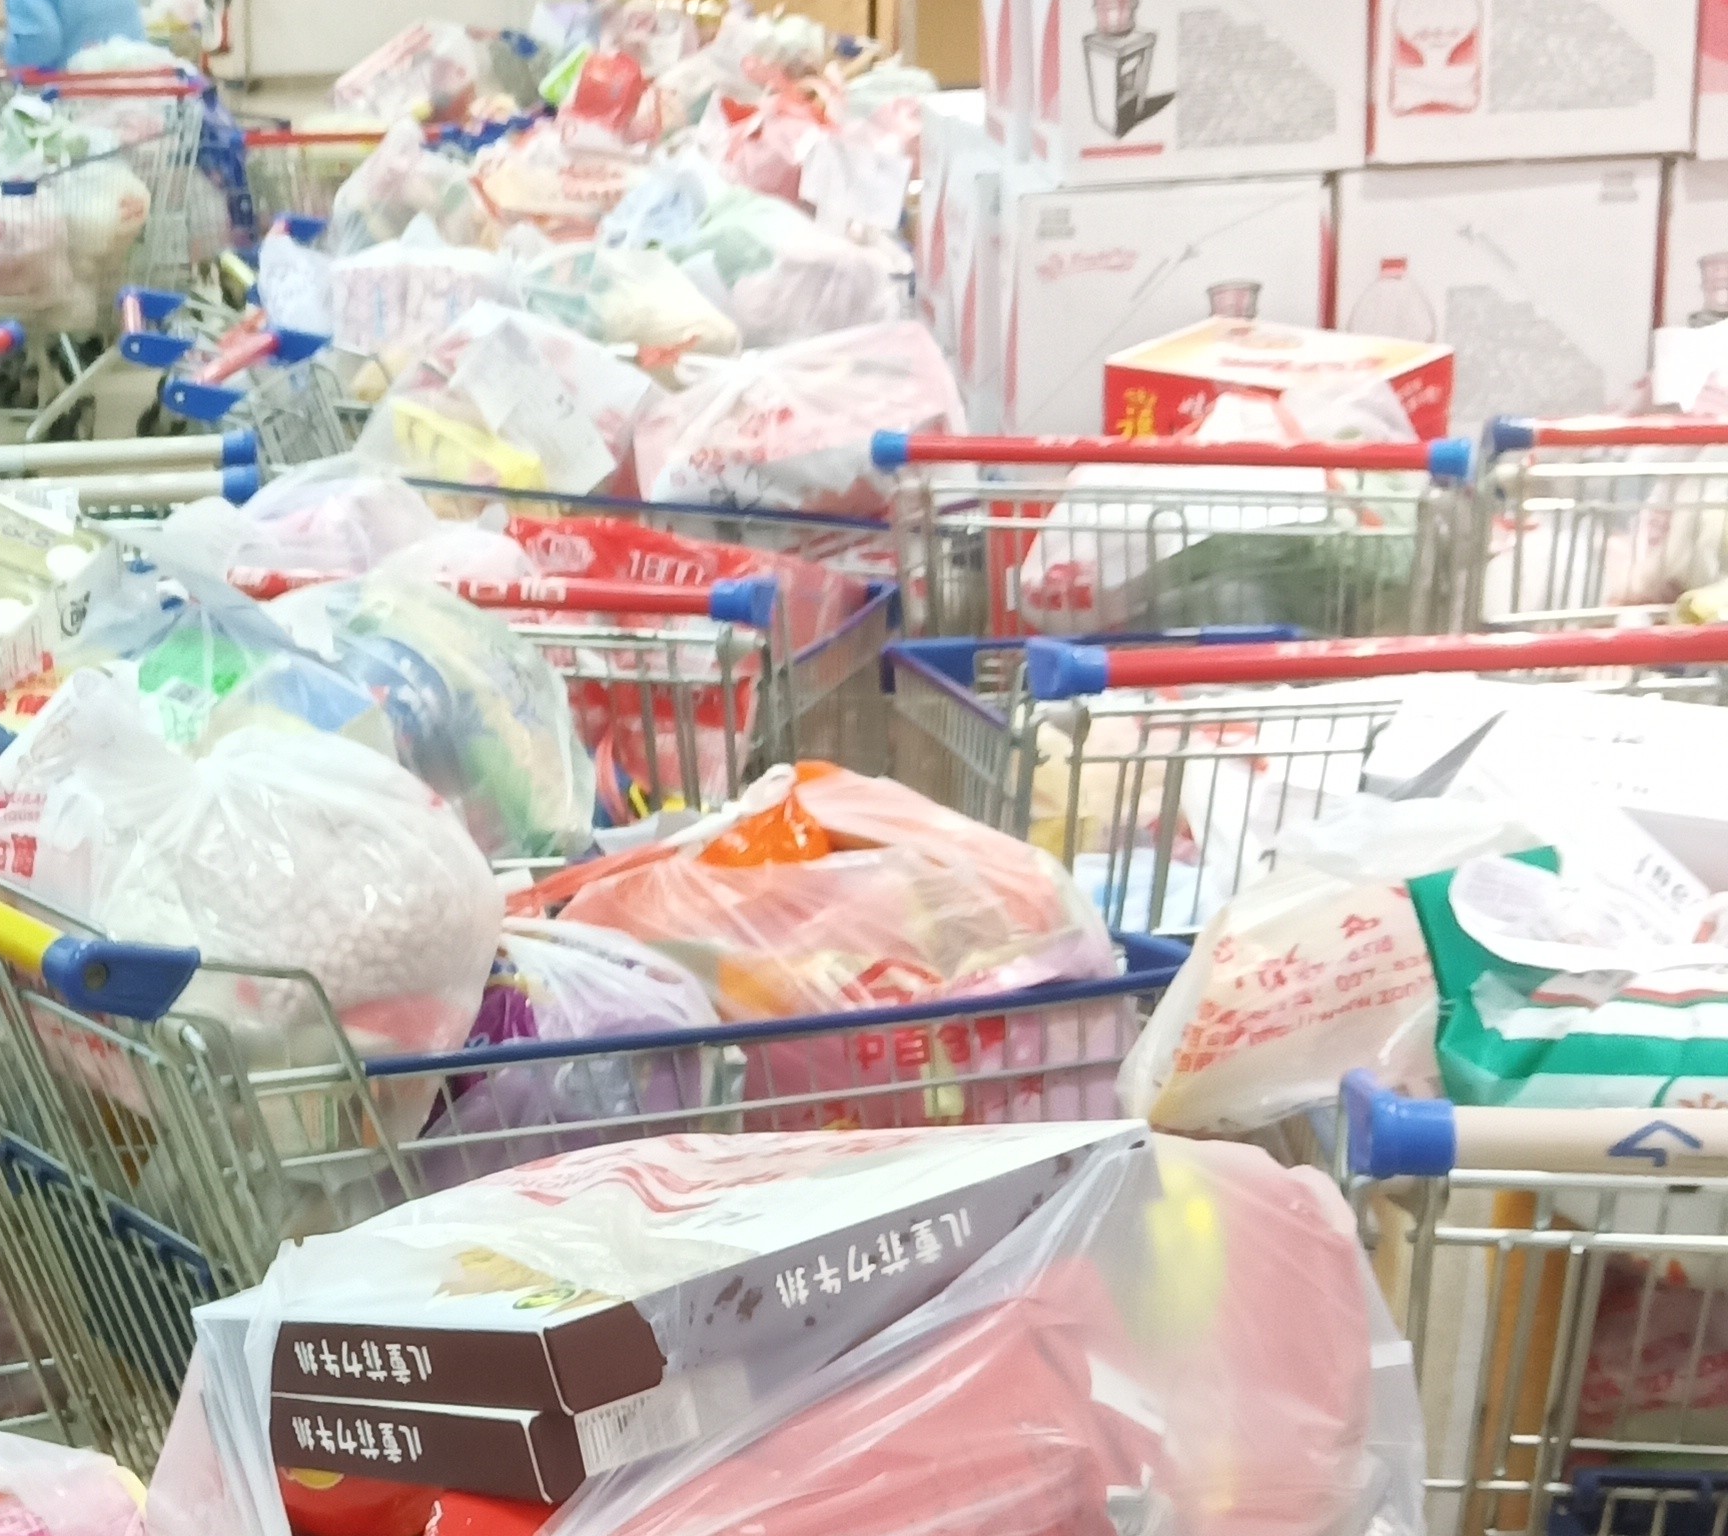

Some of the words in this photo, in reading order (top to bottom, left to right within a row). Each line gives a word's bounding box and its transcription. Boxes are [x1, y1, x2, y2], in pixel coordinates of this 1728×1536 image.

[775, 1207, 971, 1310] 儿童菲力牛排
[294, 1338, 433, 1385] 儿童菲力牛排
[291, 1414, 423, 1464] 儿童菲力牛排
